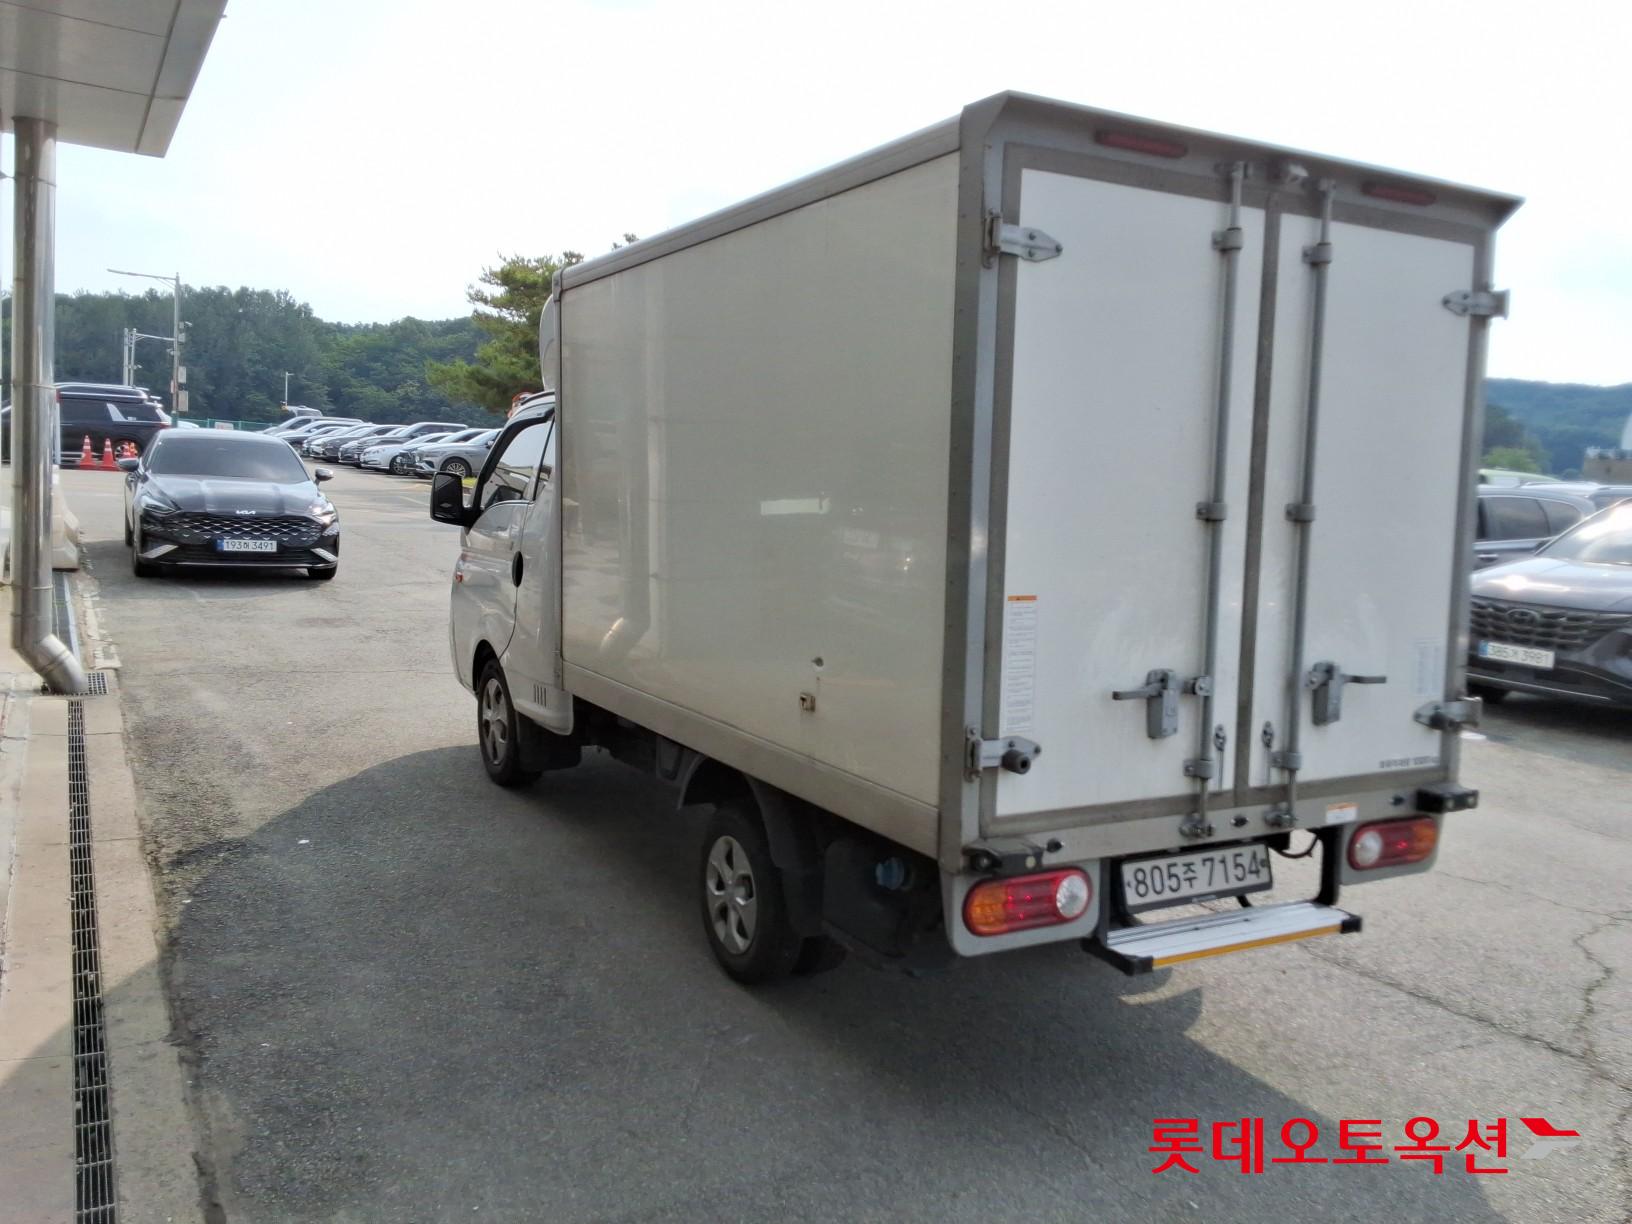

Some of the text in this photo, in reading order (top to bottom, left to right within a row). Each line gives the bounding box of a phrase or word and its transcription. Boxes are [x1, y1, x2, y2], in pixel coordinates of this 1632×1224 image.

[252, 541, 273, 551] 3491
[1133, 850, 1260, 897] 805주 7154
